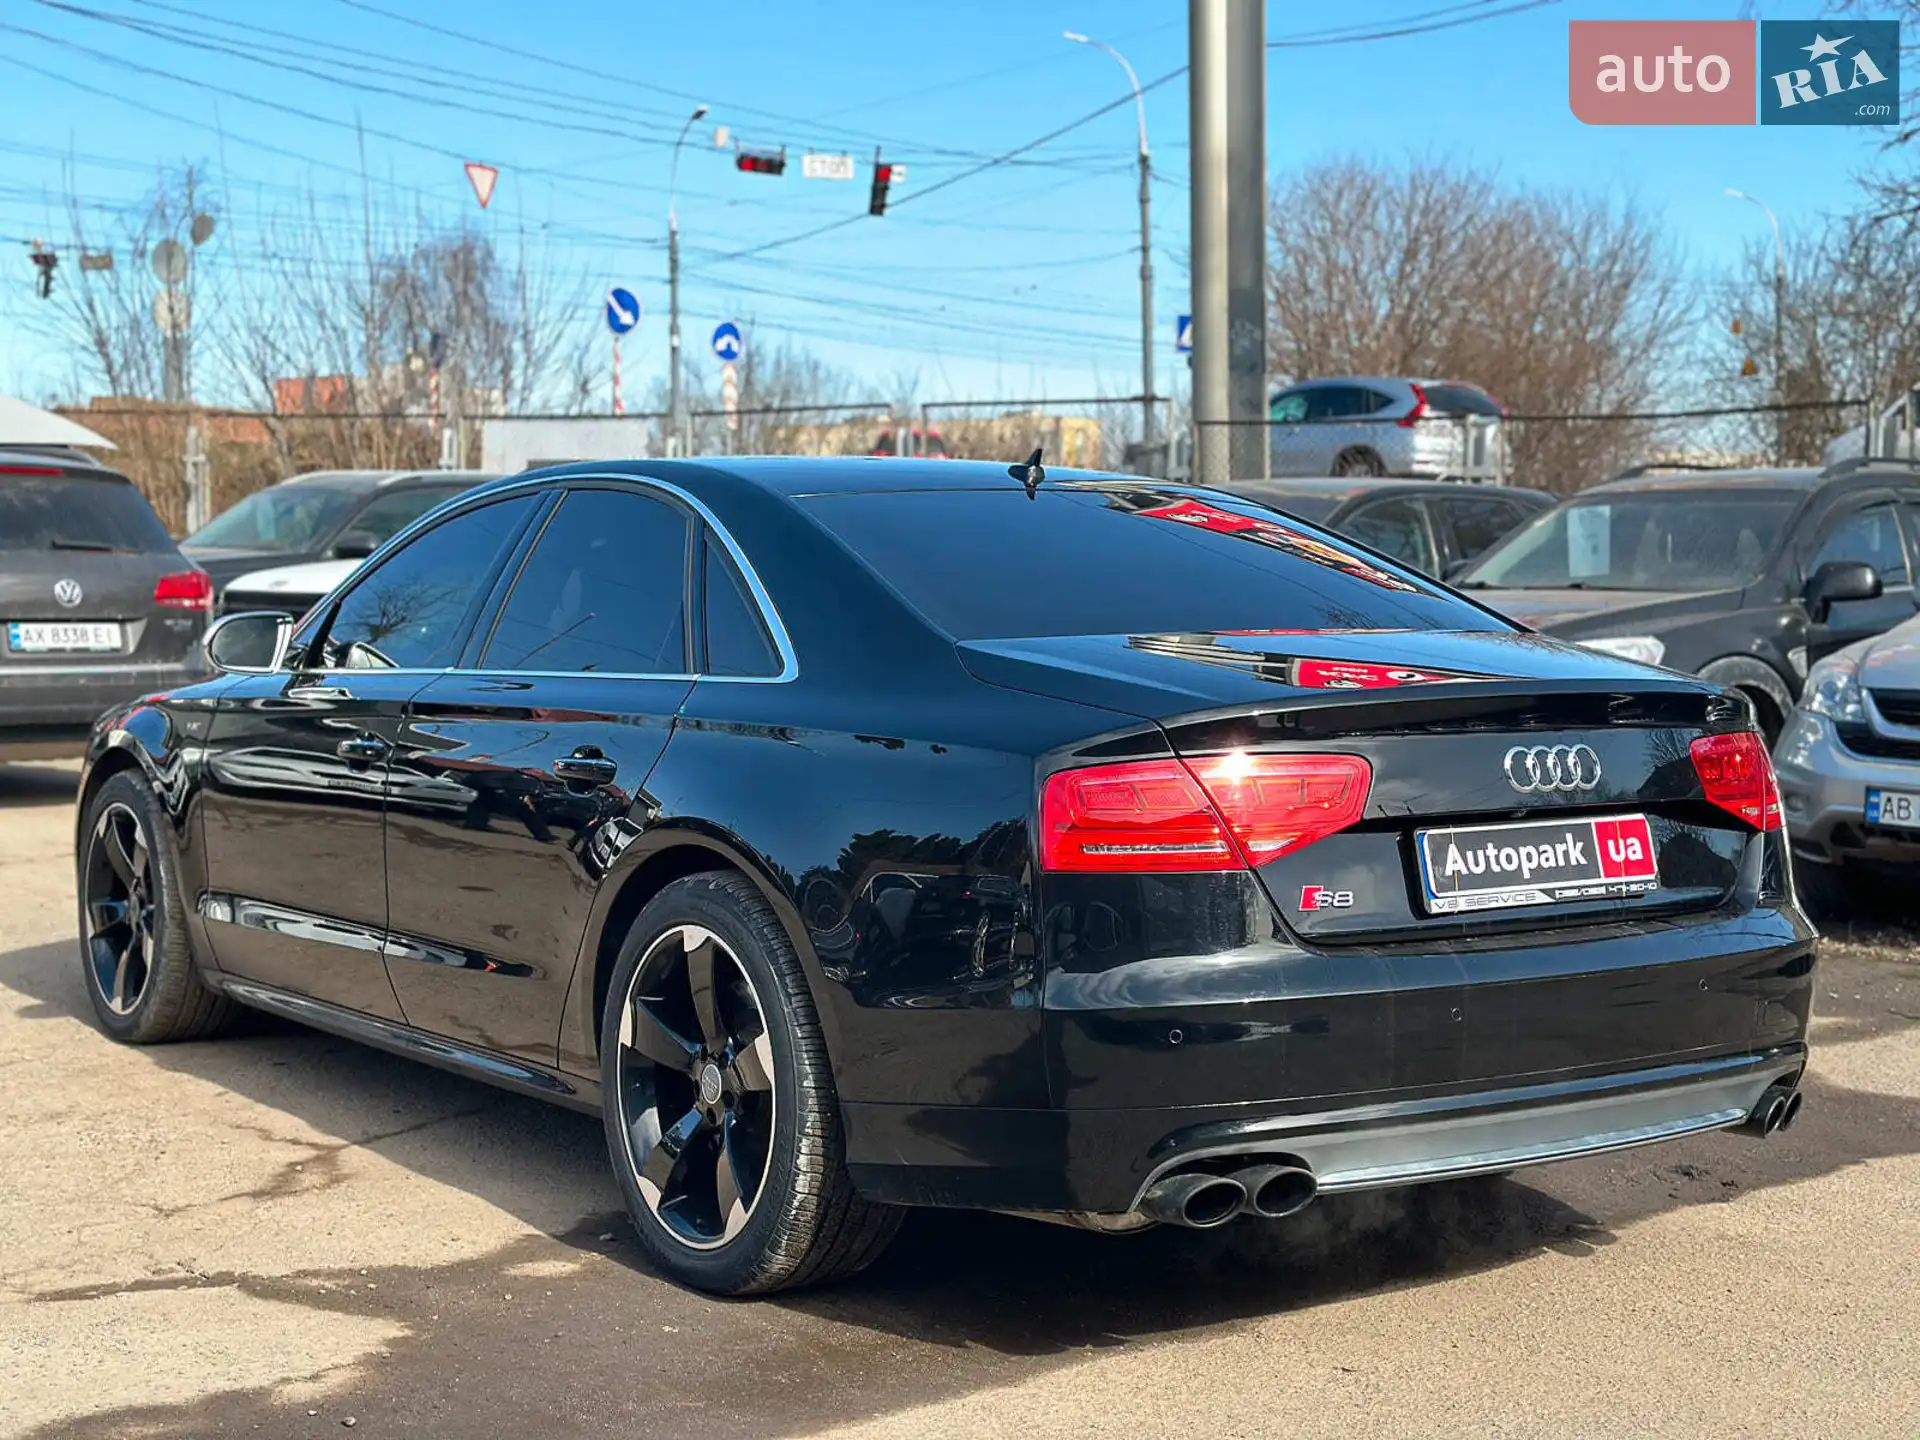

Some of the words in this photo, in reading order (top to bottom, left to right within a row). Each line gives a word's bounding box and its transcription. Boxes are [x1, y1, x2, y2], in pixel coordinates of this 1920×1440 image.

[51, 627, 90, 643] 8338
[1881, 796, 1912, 820] AB
[1444, 832, 1587, 879] Autopark
[1607, 835, 1644, 862] ua
[1314, 890, 1354, 908] S8
[1464, 892, 1537, 908] SERVICE
